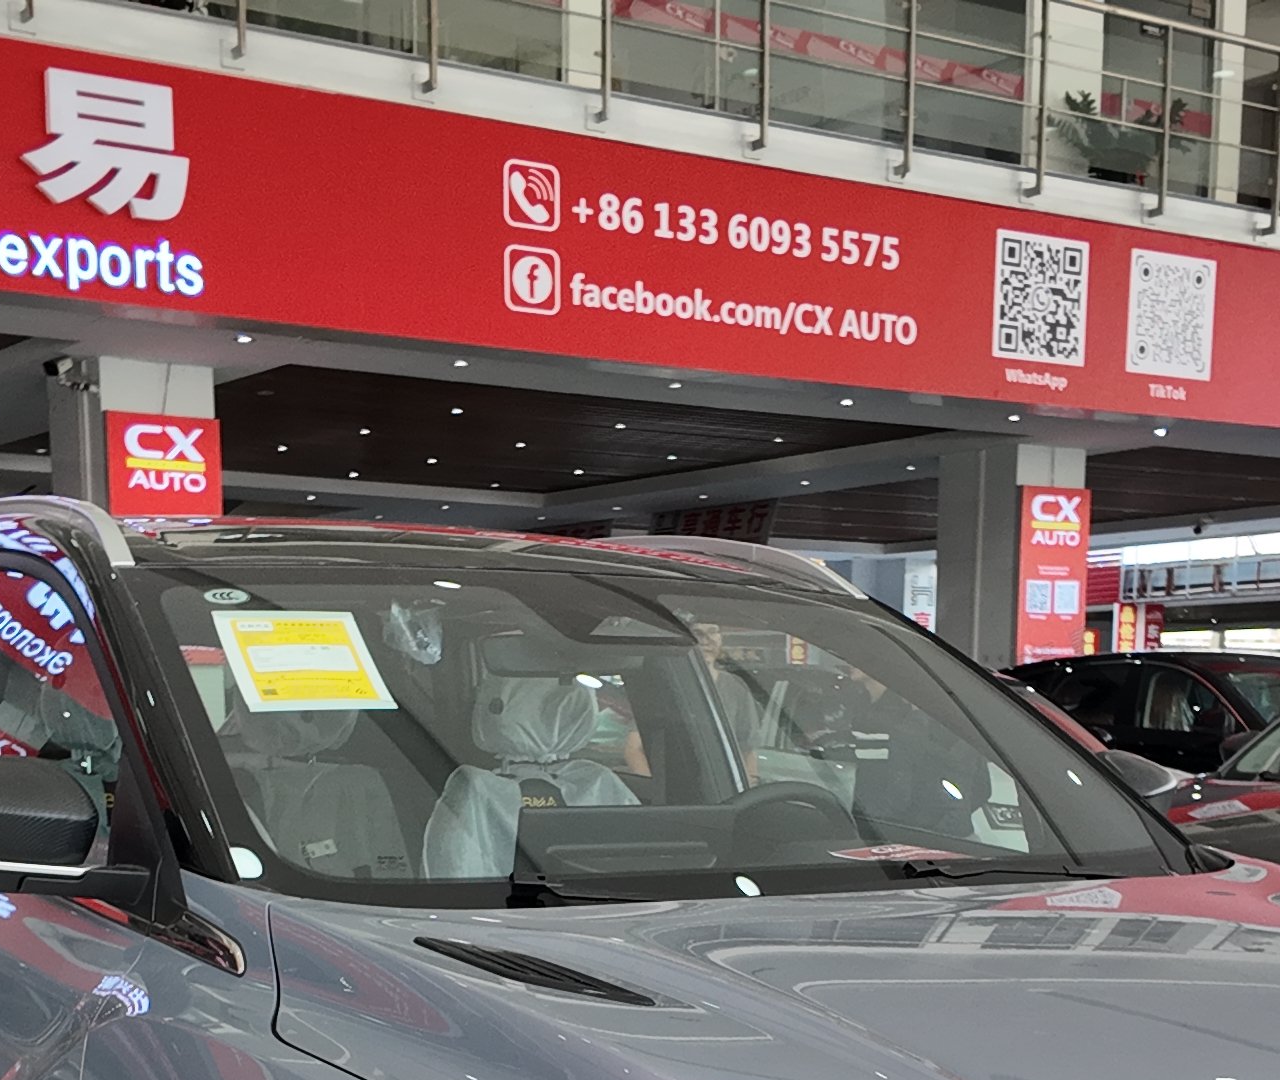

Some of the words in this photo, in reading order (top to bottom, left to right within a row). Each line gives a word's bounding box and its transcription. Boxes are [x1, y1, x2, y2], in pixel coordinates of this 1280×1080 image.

[572, 193, 644, 234] +86
[654, 203, 719, 245] 133
[728, 214, 812, 258] 6093
[820, 227, 900, 270] 5575
[569, 273, 833, 336] facebook.com/CX
[839, 309, 918, 345] AUTO
[1005, 368, 1068, 391] WhatsApp
[1148, 383, 1187, 400] TikTok
[124, 424, 205, 462] CX
[128, 469, 206, 493] AUTO
[1031, 494, 1081, 523] CX
[1030, 530, 1080, 547] AUTO
